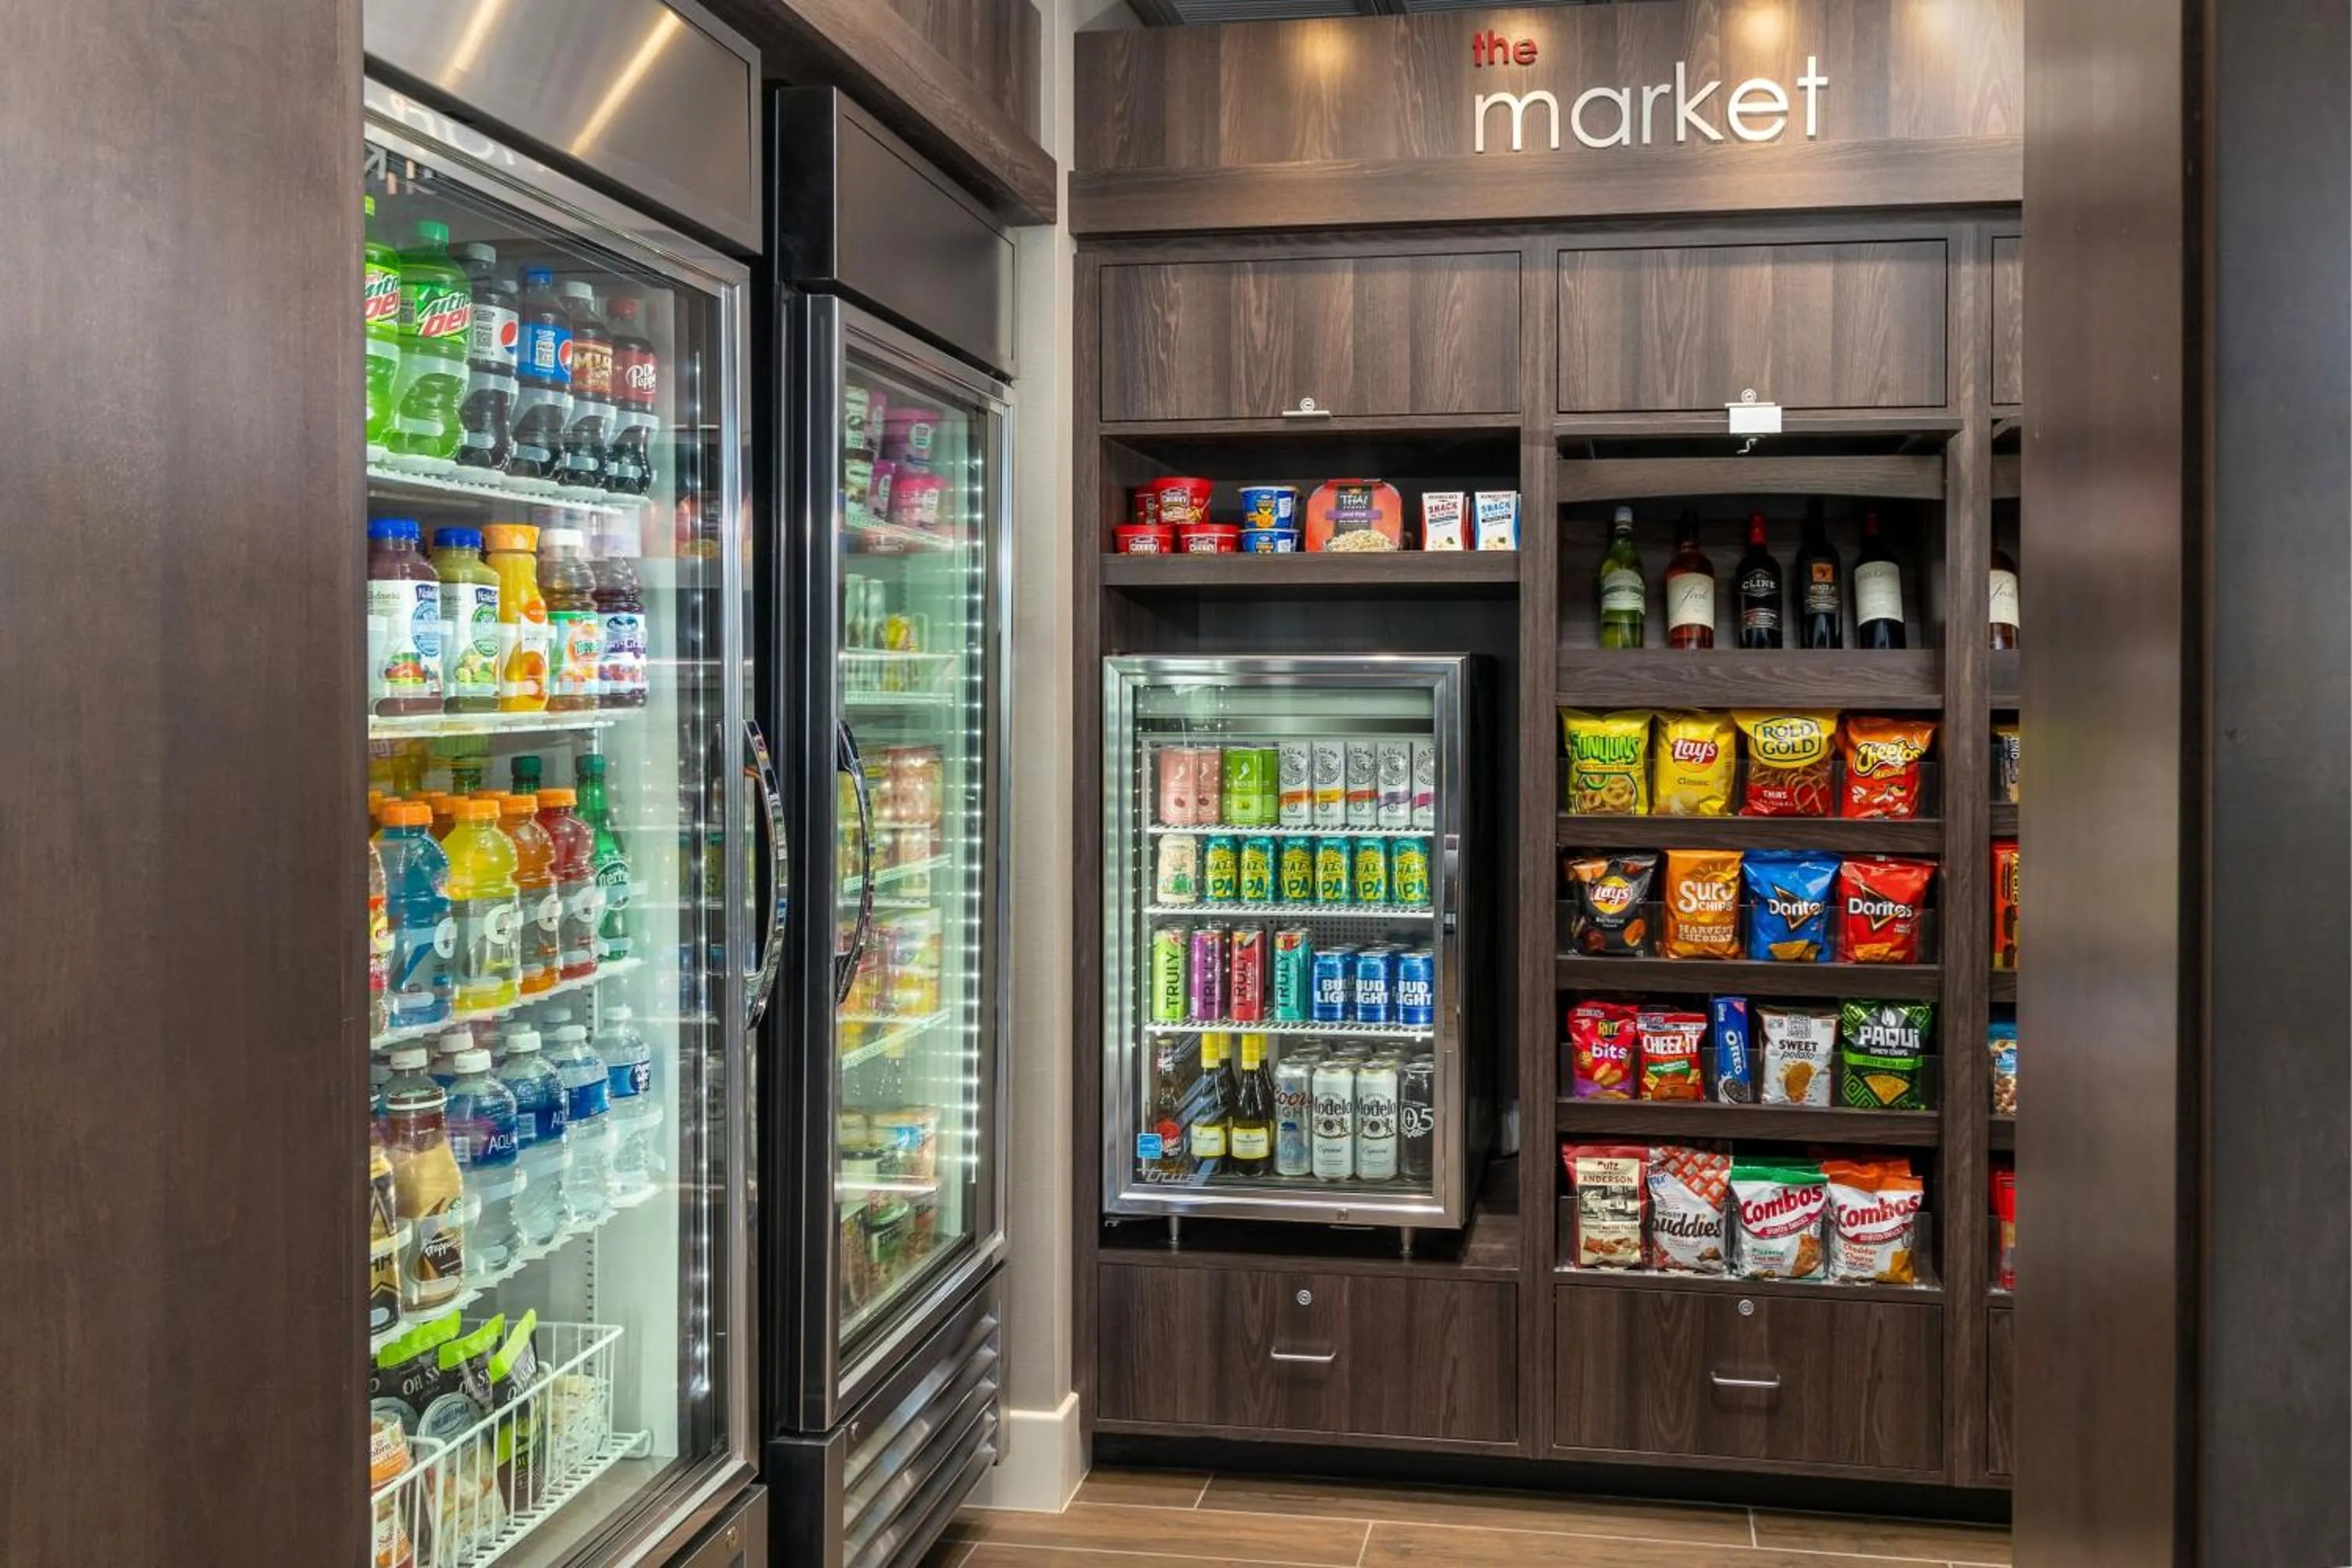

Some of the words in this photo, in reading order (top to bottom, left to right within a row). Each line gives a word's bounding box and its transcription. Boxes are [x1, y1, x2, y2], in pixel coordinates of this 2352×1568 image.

[1472, 30, 1538, 67] the
[1475, 55, 1830, 153] market
[1428, 502, 1457, 514] SNACK
[1480, 501, 1511, 514] SNACK
[1741, 579, 1777, 590] CLINE
[1762, 721, 1813, 739] ROLD
[1571, 731, 1639, 764] FUNYUNS
[1673, 739, 1718, 764] Lay's
[1762, 739, 1815, 755] GOLD
[1855, 739, 1925, 775] Cheetos
[1699, 901, 1733, 912] CHIPS
[1848, 898, 1913, 918] Doritos
[1167, 951, 1180, 1009] TRULY
[1236, 953, 1247, 1007] TRULY
[1279, 955, 1290, 1008] TRULY
[1598, 1021, 1621, 1036] RITZ
[1591, 1044, 1628, 1058] bits
[1642, 1031, 1700, 1054] CHEEZ-IT
[1778, 1040, 1819, 1052] SWEET
[1725, 1029, 1744, 1076] OREO
[1780, 1051, 1815, 1061] potato
[1356, 1097, 1396, 1116] Modelo
[1582, 1175, 1634, 1184] ANDERSON
[1740, 1185, 1824, 1225] Combos
[1835, 1194, 1921, 1229] Combos
[1842, 1242, 1877, 1255] Cheddar
